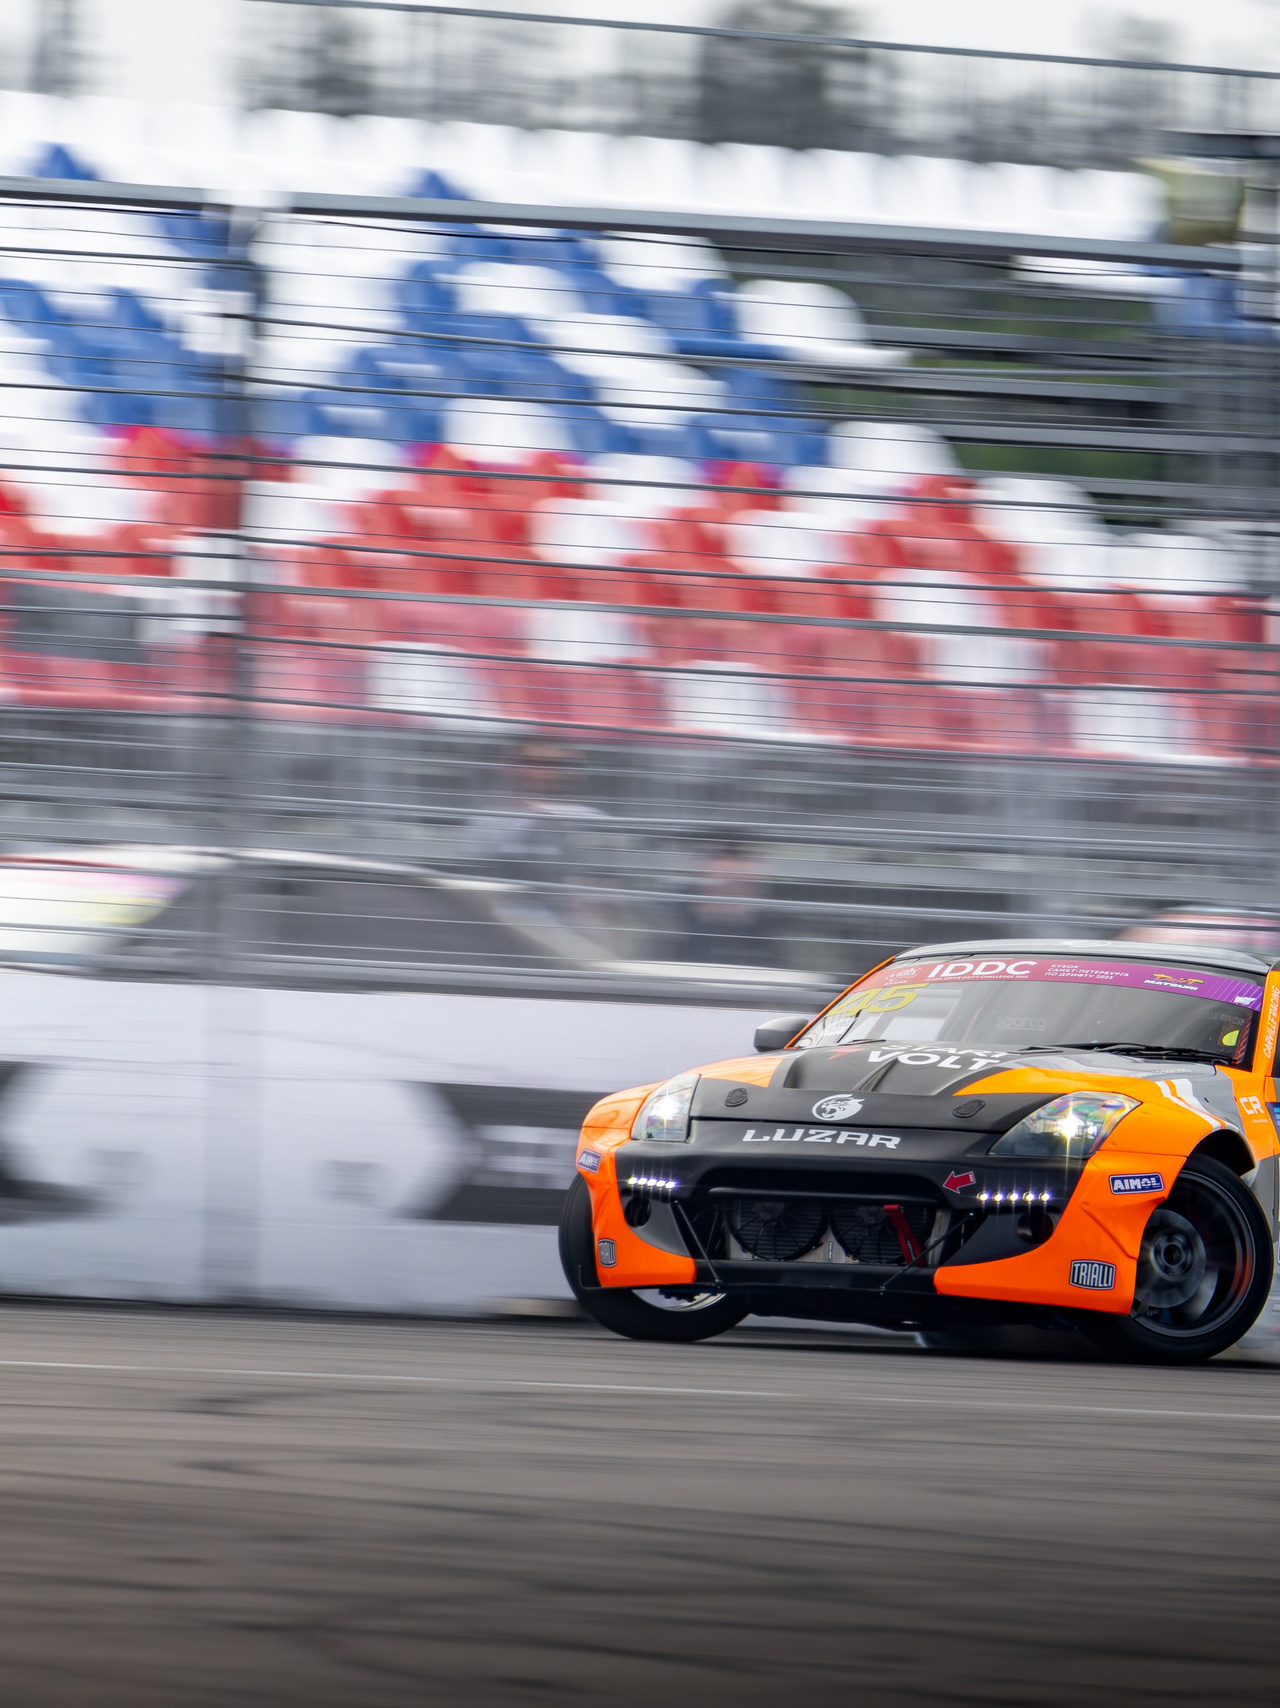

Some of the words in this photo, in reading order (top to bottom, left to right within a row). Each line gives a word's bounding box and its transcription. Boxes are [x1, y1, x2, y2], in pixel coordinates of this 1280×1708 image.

[927, 961, 1038, 978] IDDC
[1047, 968, 1130, 977] САНКТ-ПЕТЕРБУРГА
[822, 982, 930, 1018] 45
[1269, 985, 1280, 1018] RACING
[1263, 1014, 1277, 1059] CARVILLE
[867, 1050, 1000, 1071] VOLT
[880, 1044, 1009, 1058] START
[1239, 1096, 1265, 1115] CR
[742, 1128, 901, 1150] LUZAR
[1113, 1177, 1161, 1191] AIMOL
[1073, 1263, 1113, 1287] TRIALLI
